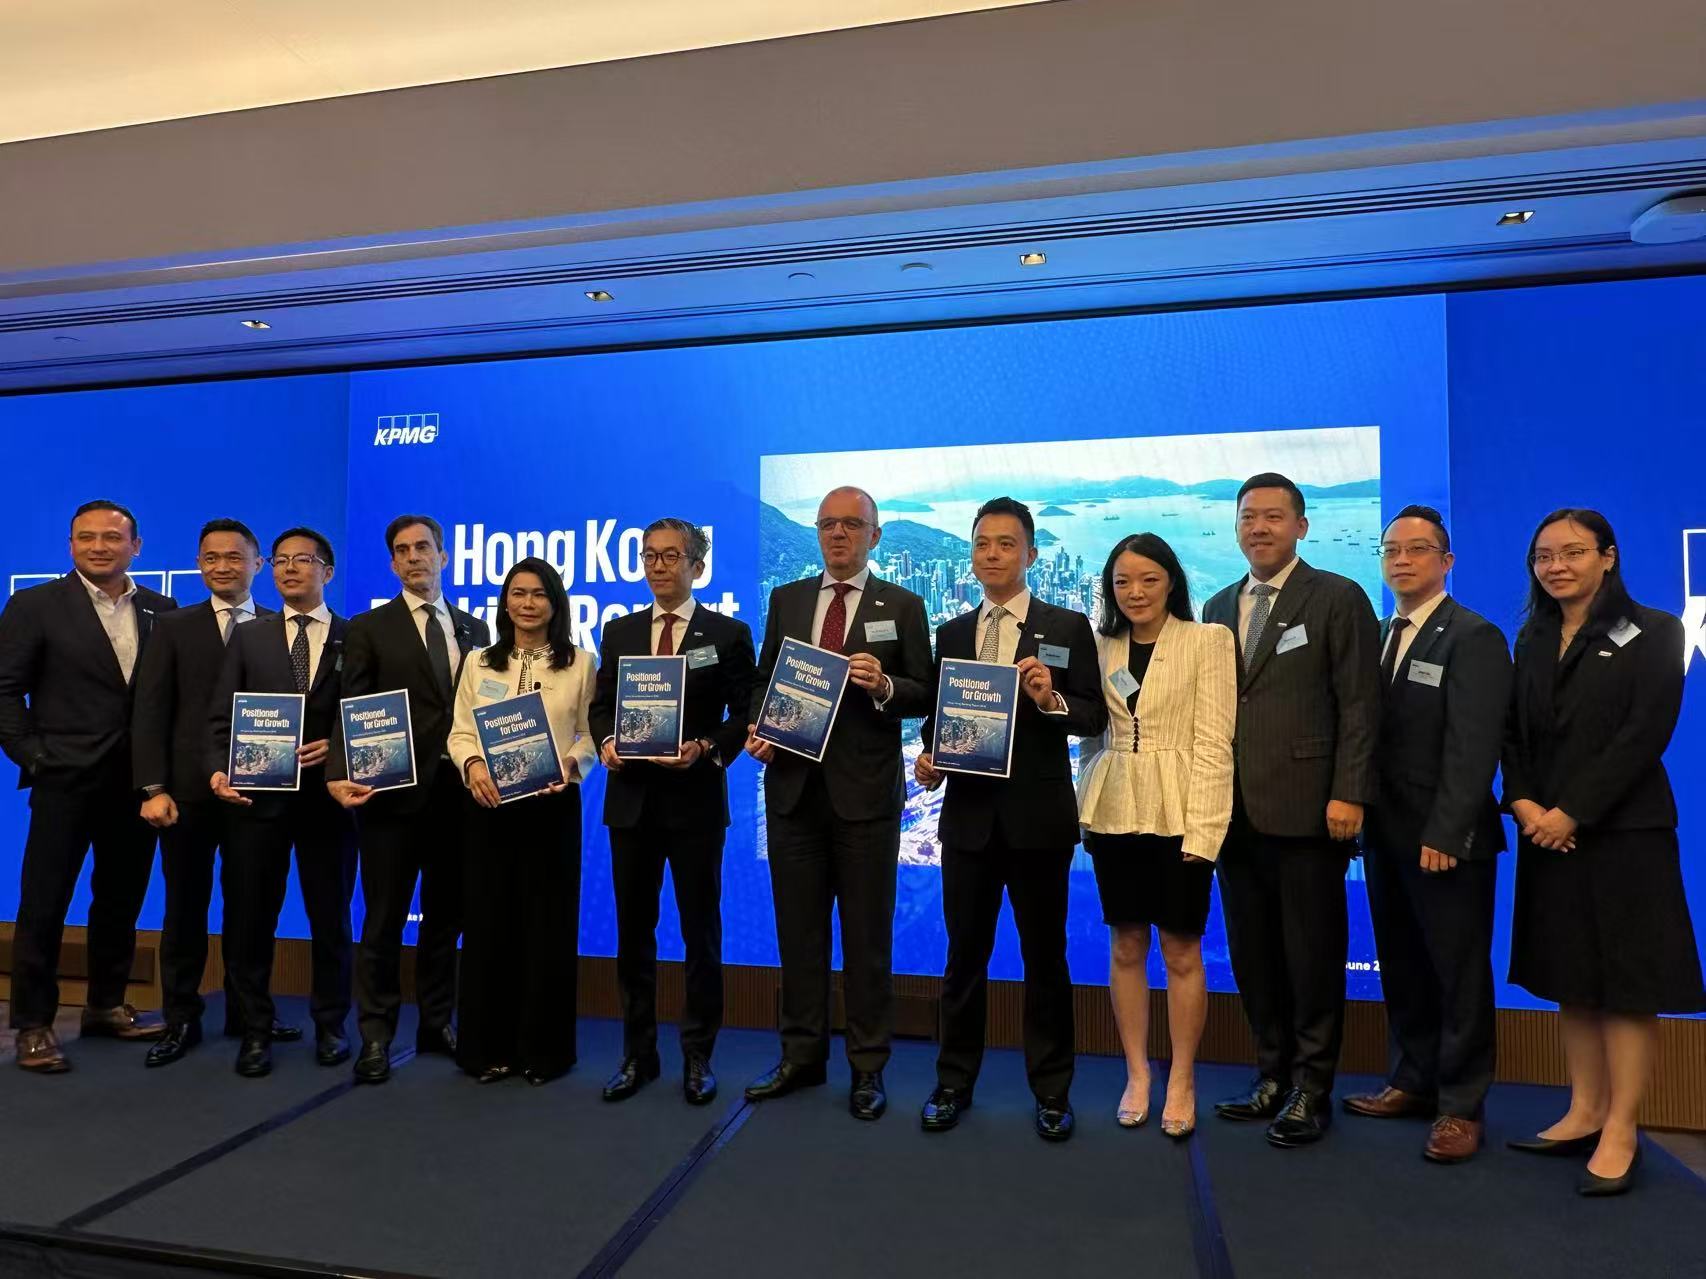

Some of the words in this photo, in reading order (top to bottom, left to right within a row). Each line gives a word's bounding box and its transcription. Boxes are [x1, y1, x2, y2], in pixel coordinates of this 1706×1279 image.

[374, 425, 436, 446] KPMG
[453, 523, 575, 591] Hong
[785, 655, 823, 676] Positioned
[626, 672, 662, 682] Positioned
[794, 670, 806, 682] for
[805, 674, 831, 691] Growth
[948, 676, 990, 691] Positioned
[637, 682, 648, 692] for
[647, 682, 672, 692] Growth
[962, 689, 974, 700] for
[974, 690, 1002, 703] Growth
[241, 708, 279, 718] Positioned
[350, 708, 386, 722] Positioned
[253, 718, 264, 727] for
[264, 718, 290, 728] Growth
[363, 720, 374, 730] for
[374, 716, 398, 729] Growth
[484, 711, 523, 730] Positioned
[500, 726, 511, 736] for
[511, 718, 537, 733] Growth
[1346, 962, 1370, 970] une
